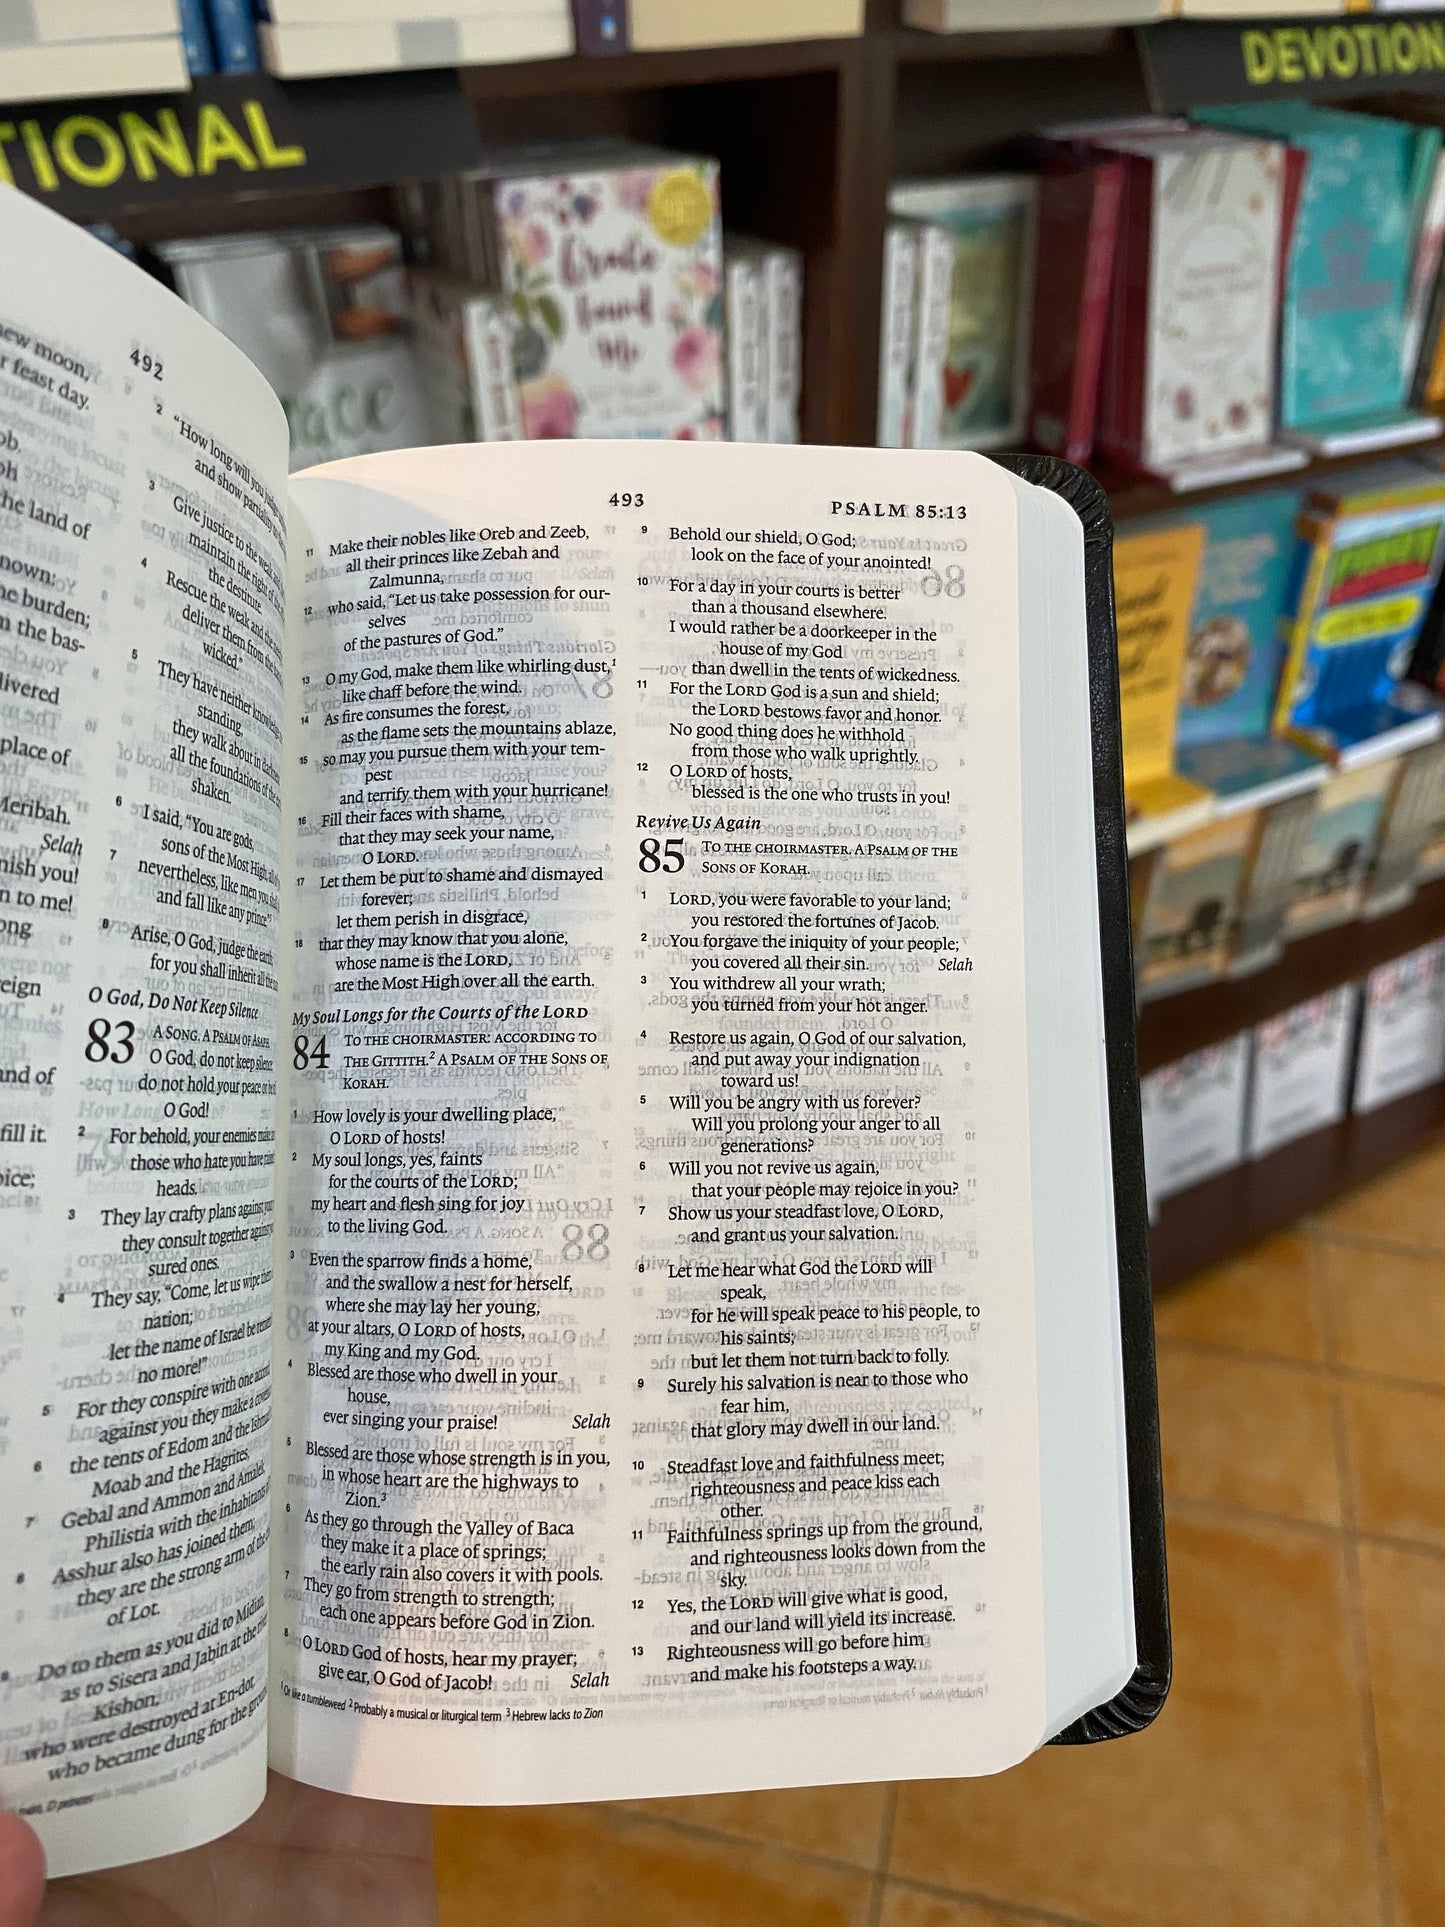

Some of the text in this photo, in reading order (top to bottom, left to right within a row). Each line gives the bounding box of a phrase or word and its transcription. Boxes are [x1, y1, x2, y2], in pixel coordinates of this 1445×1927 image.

[34, 341, 90, 383] moon,
[130, 349, 163, 381] 492
[13, 358, 90, 410] feast day.
[609, 493, 644, 508] 493
[831, 501, 967, 520] PSALM 85:13
[329, 540, 364, 557] Make
[366, 534, 398, 551] their
[401, 531, 446, 546] nobles
[449, 529, 476, 542] like
[479, 527, 515, 541] Oreb
[518, 526, 546, 539] and
[550, 525, 589, 540] Zeeb,
[641, 526, 857, 548] 9 Behold our shield, O God;
[326, 673, 337, 685] O
[339, 672, 359, 688] my
[361, 665, 392, 683] God,
[395, 663, 433, 678] make
[436, 660, 475, 676] them
[476, 658, 503, 673] like
[507, 659, 571, 677] whirling
[197, 704, 243, 737] standing,
[191, 777, 232, 805] shaken.
[636, 815, 761, 832] Revive Us Again
[40, 833, 83, 857] Selah
[638, 838, 685, 873] 85
[641, 891, 951, 912] 1 LORD, you were favorable to your land;
[938, 958, 974, 972] Selah
[89, 986, 259, 1020] O God, Do Not Keep Silence
[292, 1003, 589, 1027] My Soul Longs for the Courts of the LORD
[85, 1018, 135, 1064] 83
[293, 1034, 331, 1070] 84
[164, 1102, 209, 1118] O God!
[313, 1109, 343, 1124] How
[346, 1108, 385, 1126] lovely
[388, 1108, 400, 1122] is
[403, 1110, 438, 1126] your
[441, 1107, 510, 1125] dwelling
[513, 1106, 557, 1124] place,
[156, 1179, 197, 1197] heads.
[148, 1257, 220, 1277] sured ones.
[143, 1310, 193, 1331] nation;
[137, 1369, 158, 1384] no
[572, 1413, 611, 1429] Selah
[61, 1504, 113, 1529] Gebal
[117, 1497, 149, 1519] and
[152, 1483, 211, 1513] Ammon
[213, 1477, 235, 1496] and
[632, 1632, 925, 1662] 13 Righteousness will go before him
[690, 1658, 918, 1682] and make his footsteps a way.
[93, 1694, 160, 1722] Kishon,
[354, 1702, 388, 1719] Probably
[390, 1708, 395, 1718] a
[396, 1708, 428, 1720] musical
[430, 1711, 439, 1720] or
[441, 1709, 479, 1724] liturgical
[481, 1711, 502, 1722] term
[512, 1710, 547, 1722] Hebrew
[549, 1709, 571, 1721] lacks
[573, 1709, 582, 1720] to
[583, 1707, 604, 1720] Zion
